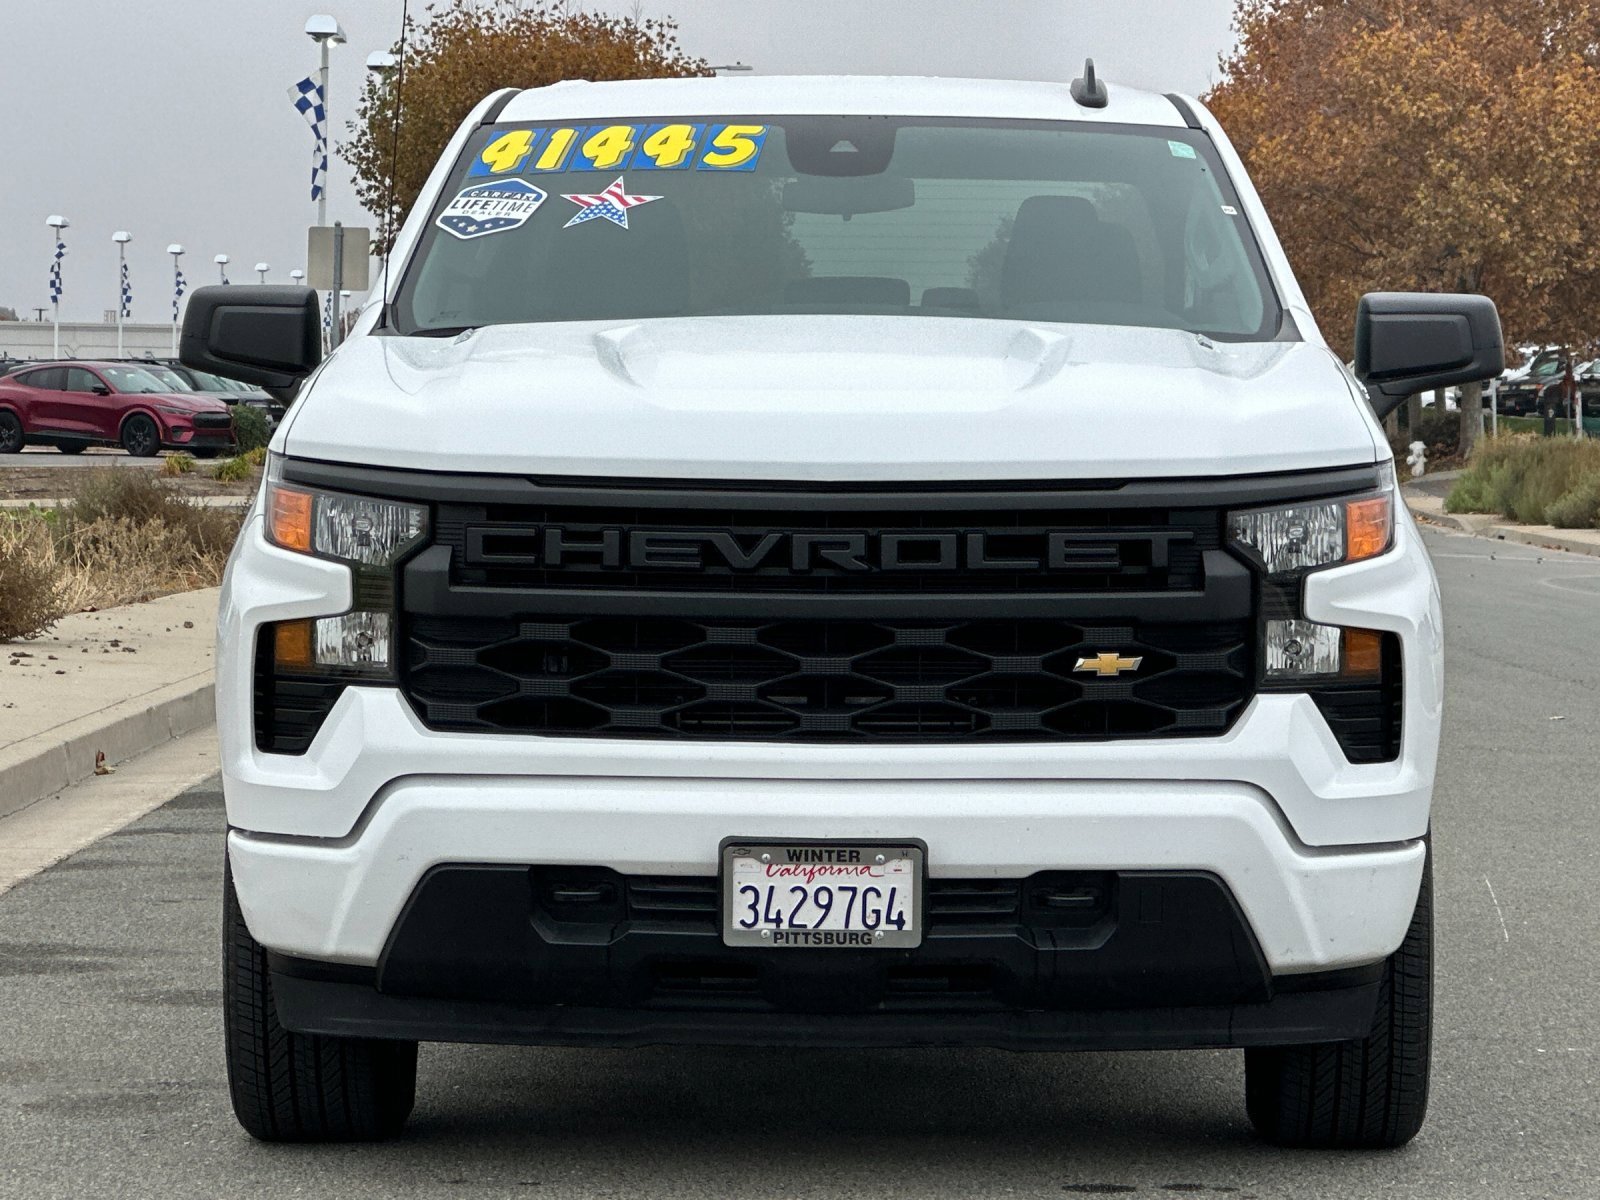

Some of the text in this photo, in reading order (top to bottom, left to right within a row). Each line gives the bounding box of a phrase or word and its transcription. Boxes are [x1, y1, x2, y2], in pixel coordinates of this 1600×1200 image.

[481, 124, 767, 174] 41445
[470, 190, 538, 202] CARFAX
[450, 199, 537, 214] LIFETIME
[462, 209, 512, 217] DEALER
[465, 526, 1195, 572] CHEVROLET
[786, 849, 861, 863] WINTER
[766, 864, 885, 884] California
[739, 885, 906, 931] 34297G4
[773, 931, 873, 946] PITTSBURG
